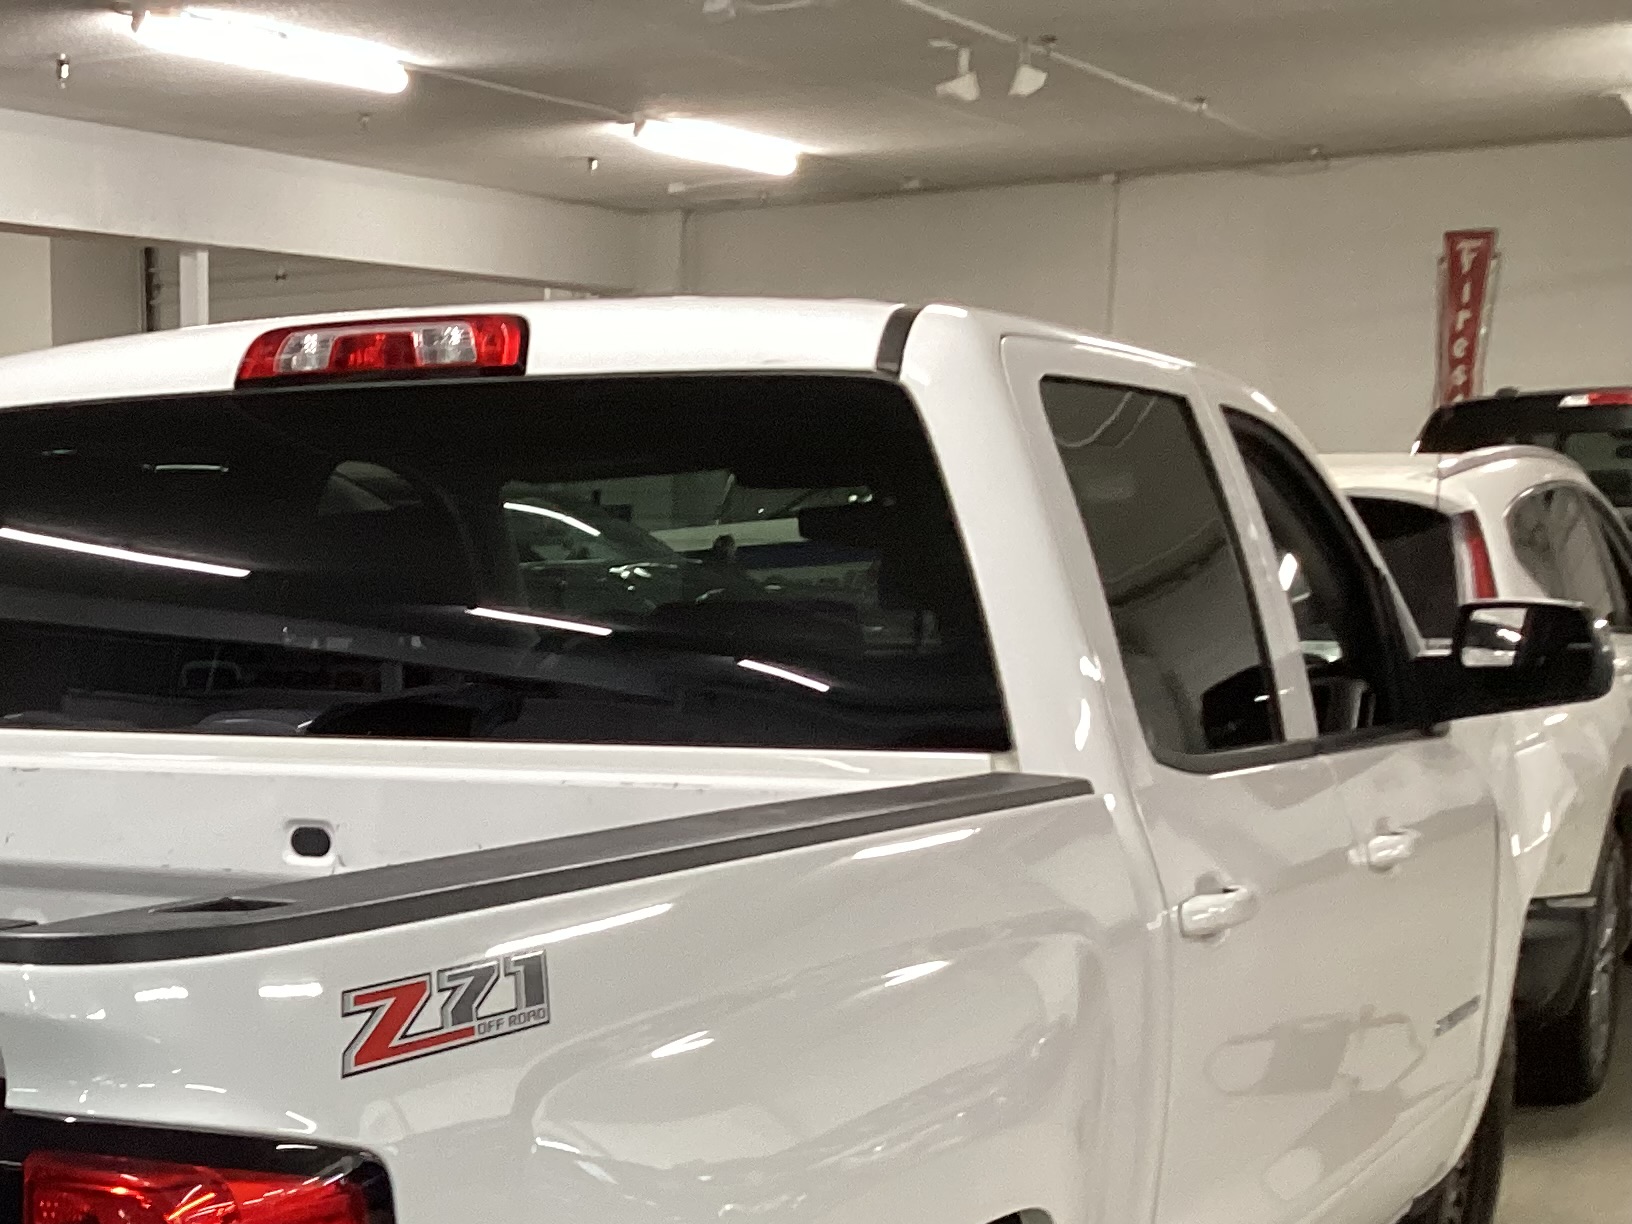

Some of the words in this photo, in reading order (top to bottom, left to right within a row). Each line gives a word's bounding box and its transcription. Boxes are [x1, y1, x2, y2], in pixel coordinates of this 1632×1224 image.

[341, 949, 550, 1079] Z71
[477, 1017, 505, 1035] OFF
[508, 1007, 546, 1028] ROAD
